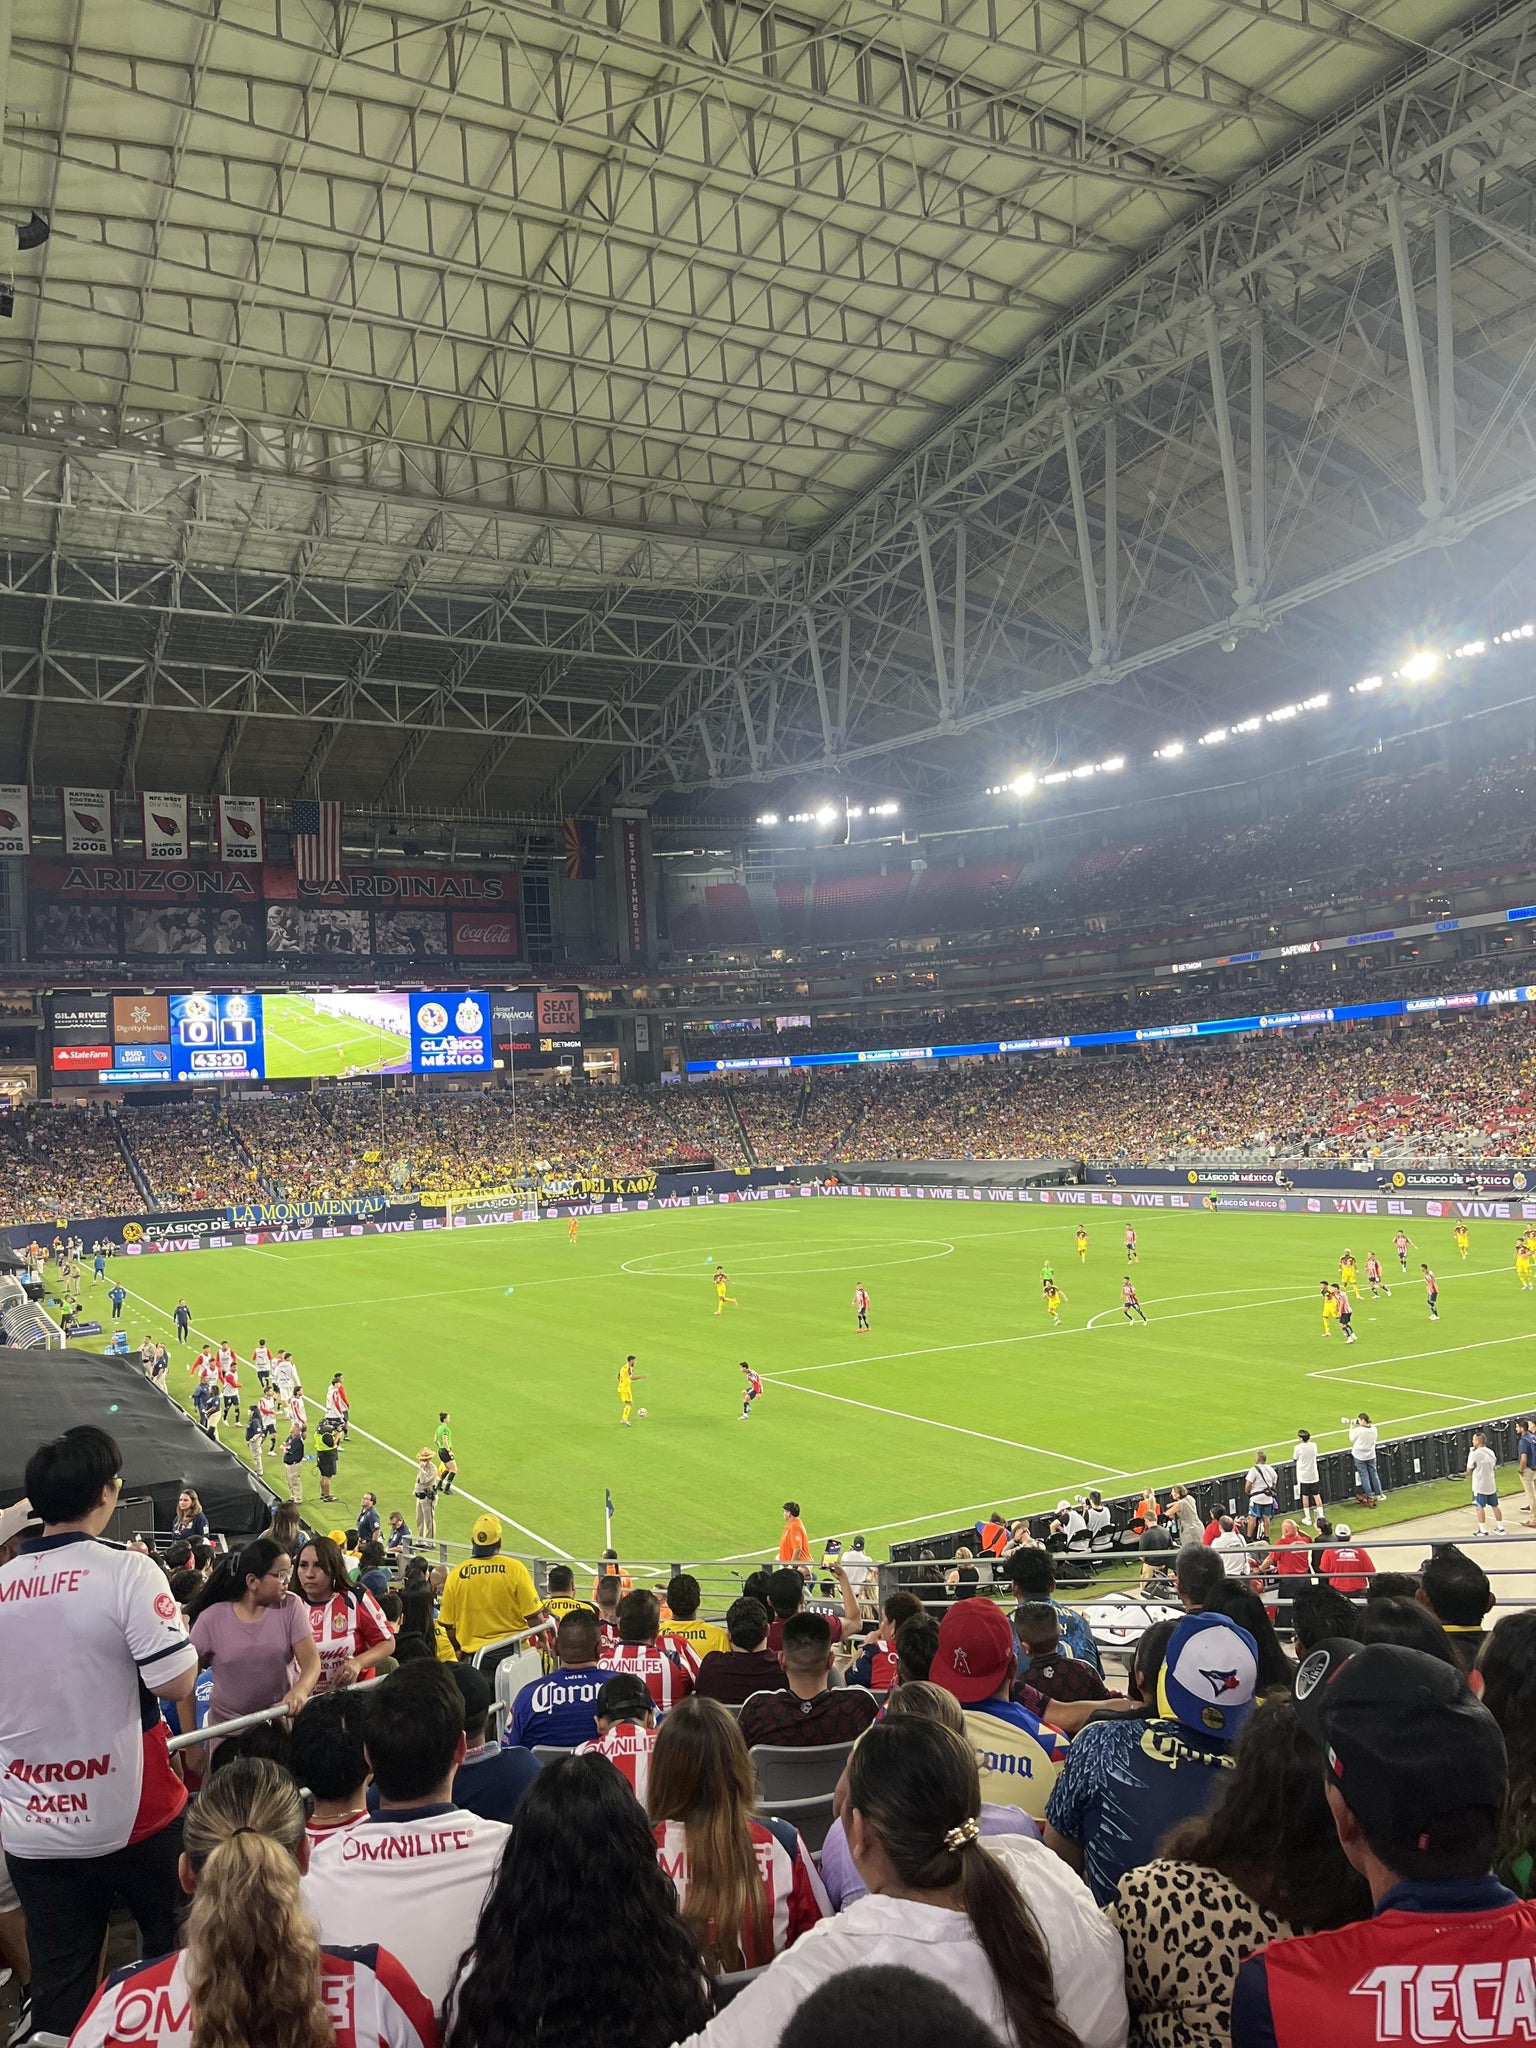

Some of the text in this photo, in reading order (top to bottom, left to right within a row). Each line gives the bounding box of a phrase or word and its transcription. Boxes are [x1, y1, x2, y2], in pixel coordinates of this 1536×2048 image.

[72, 842, 107, 851] 2008
[151, 847, 183, 856] 2009
[226, 848, 258, 857] 2015
[61, 866, 255, 894] ARIZONA
[627, 832, 640, 919] ESTABLISHED
[298, 872, 504, 900] CARDINALS
[1434, 919, 1460, 932] COX
[456, 923, 513, 944] Coca-Cola
[1281, 943, 1311, 956] SAFEWAY
[543, 1000, 574, 1012] SEAT
[54, 1012, 77, 1020] GILA
[542, 1012, 576, 1025] GEEK
[116, 1024, 141, 1033] Dignity
[188, 1020, 208, 1043] 0
[231, 1020, 244, 1042] 1
[420, 1036, 484, 1052] CLÁSICO
[498, 1042, 532, 1050] verizon
[194, 1052, 244, 1067] 43:20
[420, 1052, 485, 1067] MÉXICO
[1241, 1172, 1274, 1182] MÉXICO
[1406, 1173, 1511, 1186] CLÁSICO DE XICO
[582, 1178, 611, 1195] DEL
[612, 1175, 658, 1194] KAOZ
[820, 1185, 863, 1196] VIVE EL
[875, 1186, 912, 1198] VIVE EL
[658, 1194, 714, 1208] VIVE EL
[738, 1188, 791, 1201] VIVE EL
[929, 1187, 970, 1200] VIVE EL
[987, 1189, 1034, 1202] VIVE EL
[1056, 1191, 1108, 1205] VIVE EL
[1131, 1194, 1190, 1207] VIVE EL
[231, 1205, 255, 1221] LA
[260, 1197, 384, 1220] MONUMENTAL
[568, 1201, 628, 1216] VIVE EL
[1251, 1199, 1278, 1208] MÉXICO
[1332, 1199, 1413, 1215] VIVE EL
[1457, 1202, 1511, 1218] VIVE
[374, 1218, 443, 1233] VIVE EL
[476, 1211, 514, 1225] VIVE
[145, 1221, 208, 1237] CLÁSICO
[210, 1221, 231, 1231] DE
[271, 1226, 344, 1243] VIVE EL
[157, 1236, 232, 1253] VIVE EL
[458, 1563, 506, 1580] Corona
[598, 1659, 660, 1672] OMNILIFE
[531, 1681, 604, 1715] Coro
[580, 1736, 657, 1758] OMNILIF
[3, 1753, 111, 1784] AKRON
[980, 1747, 1034, 1779] ona
[26, 1792, 88, 1813] AXEN
[25, 1814, 91, 1824] CAPITAL
[342, 1830, 470, 1862] OMNILIFE
